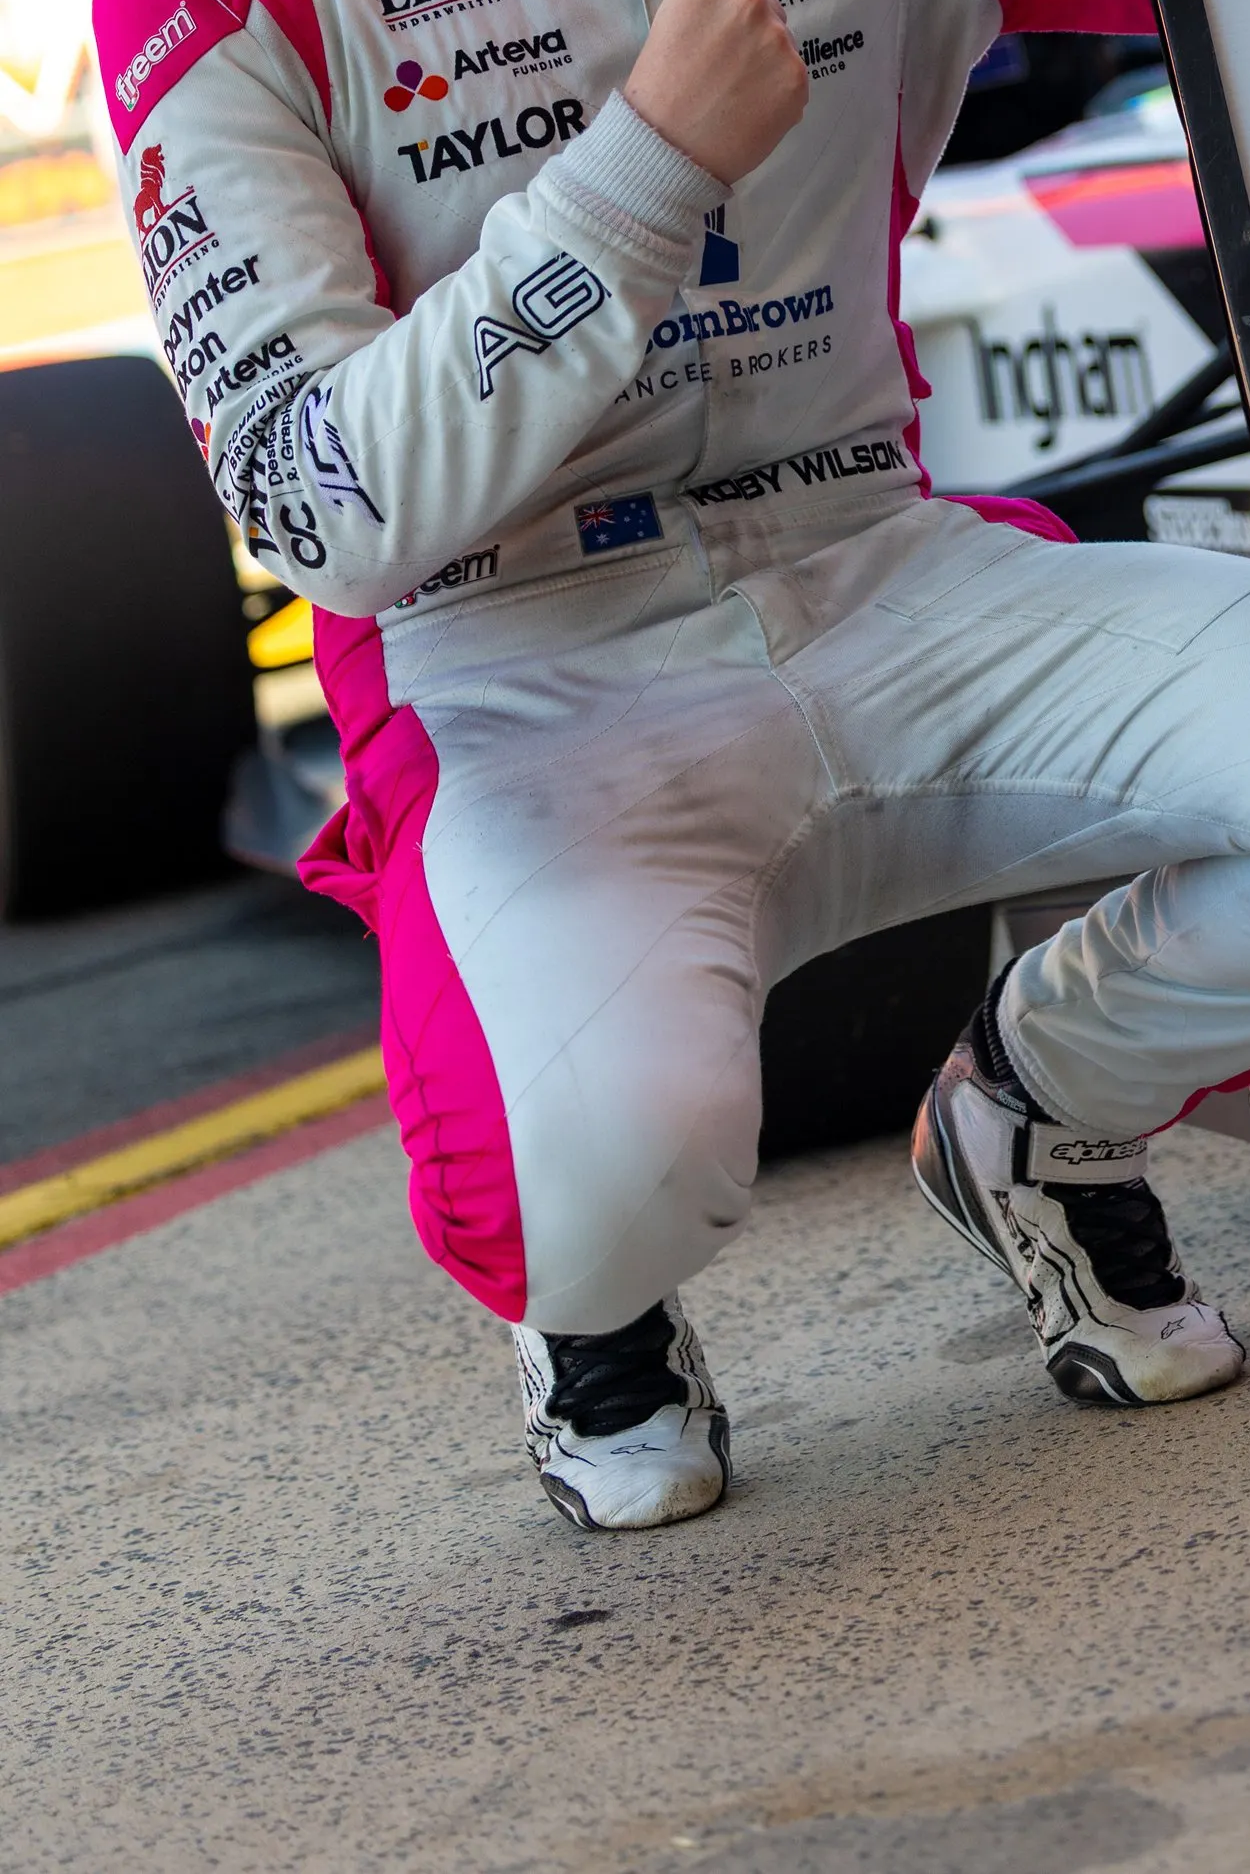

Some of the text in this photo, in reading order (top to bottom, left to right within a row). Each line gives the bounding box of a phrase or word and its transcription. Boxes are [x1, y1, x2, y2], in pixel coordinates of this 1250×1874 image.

[454, 28, 567, 80] Arteva
[512, 54, 573, 77] FUNDING
[798, 30, 865, 66] ilience
[808, 61, 846, 80] ance
[398, 98, 589, 184] TAYLOR
[645, 285, 834, 355] omBrown
[206, 333, 296, 418] Arteva
[731, 334, 832, 377] BROKERS
[787, 441, 908, 485] WILSON
